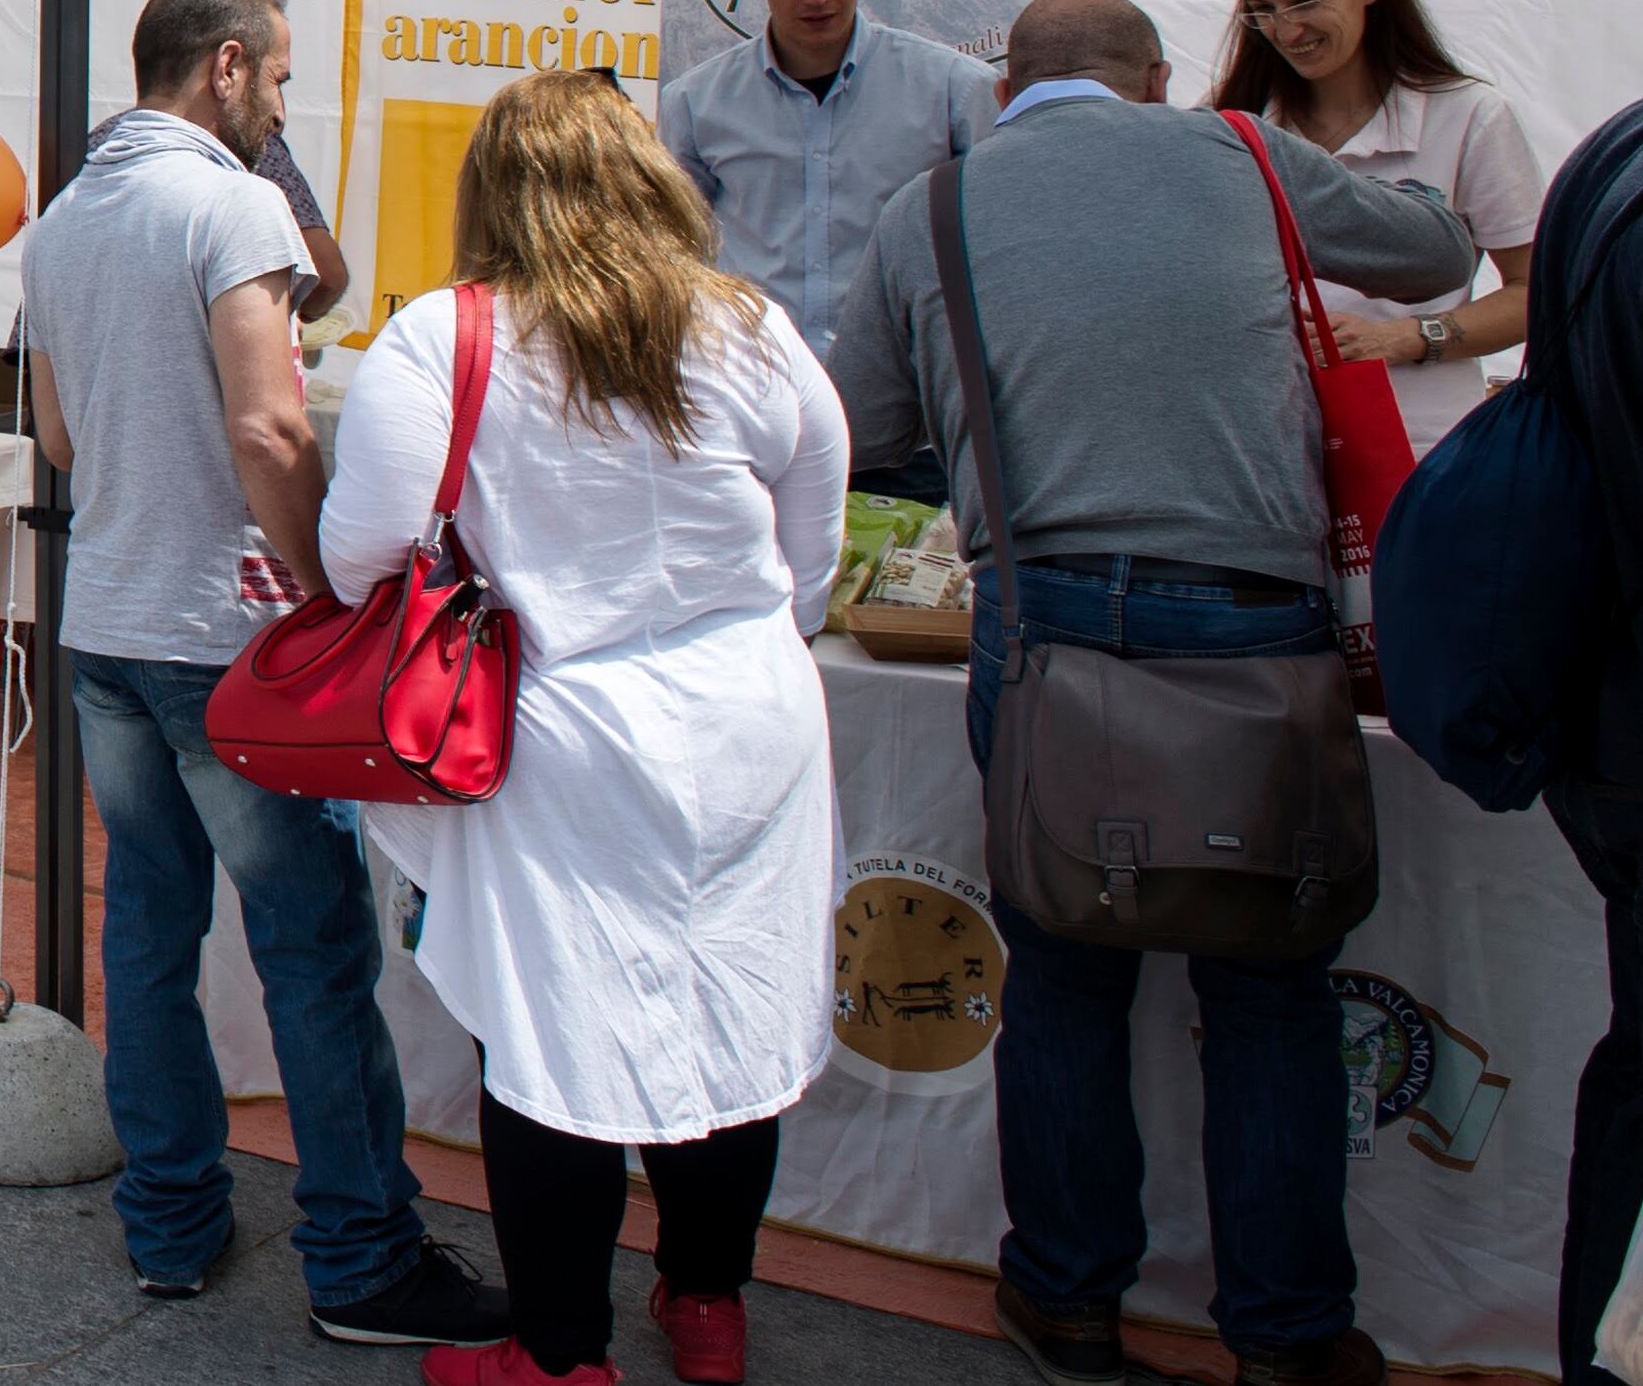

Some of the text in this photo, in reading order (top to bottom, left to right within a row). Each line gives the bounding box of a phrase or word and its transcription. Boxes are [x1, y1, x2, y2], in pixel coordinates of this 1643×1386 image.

[381, 6, 659, 80] arancion
[1336, 528, 1364, 545] MAY
[1341, 545, 1371, 562] 2016
[854, 858, 995, 917] TUTELA DEL FORM
[836, 896, 984, 979] SILTER
[1328, 978, 1430, 1112] LA VALCAMONICA
